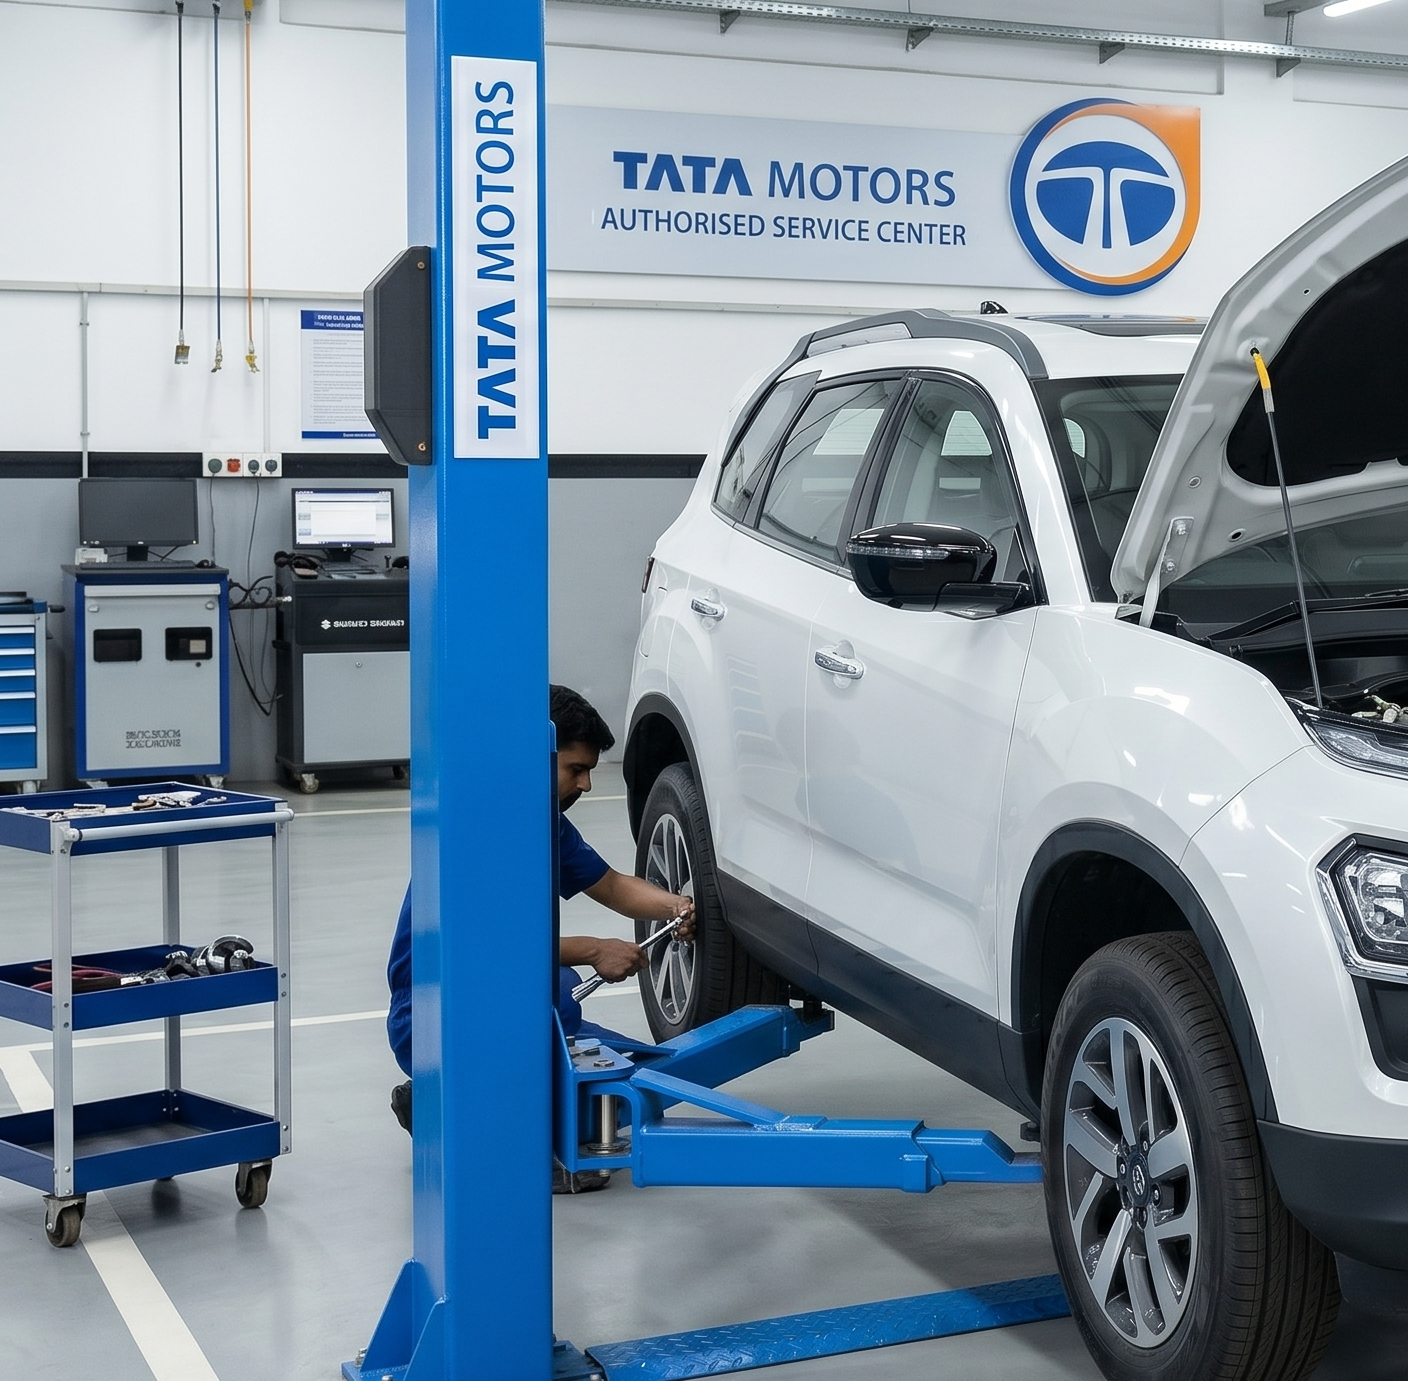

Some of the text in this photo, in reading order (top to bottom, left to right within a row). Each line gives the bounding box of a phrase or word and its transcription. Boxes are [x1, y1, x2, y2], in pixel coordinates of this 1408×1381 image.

[613, 150, 956, 207] TATA MOTORS
[601, 207, 967, 246] AUTHORISED SERVICE CENTER
[475, 81, 516, 439] TATA MOTORS
